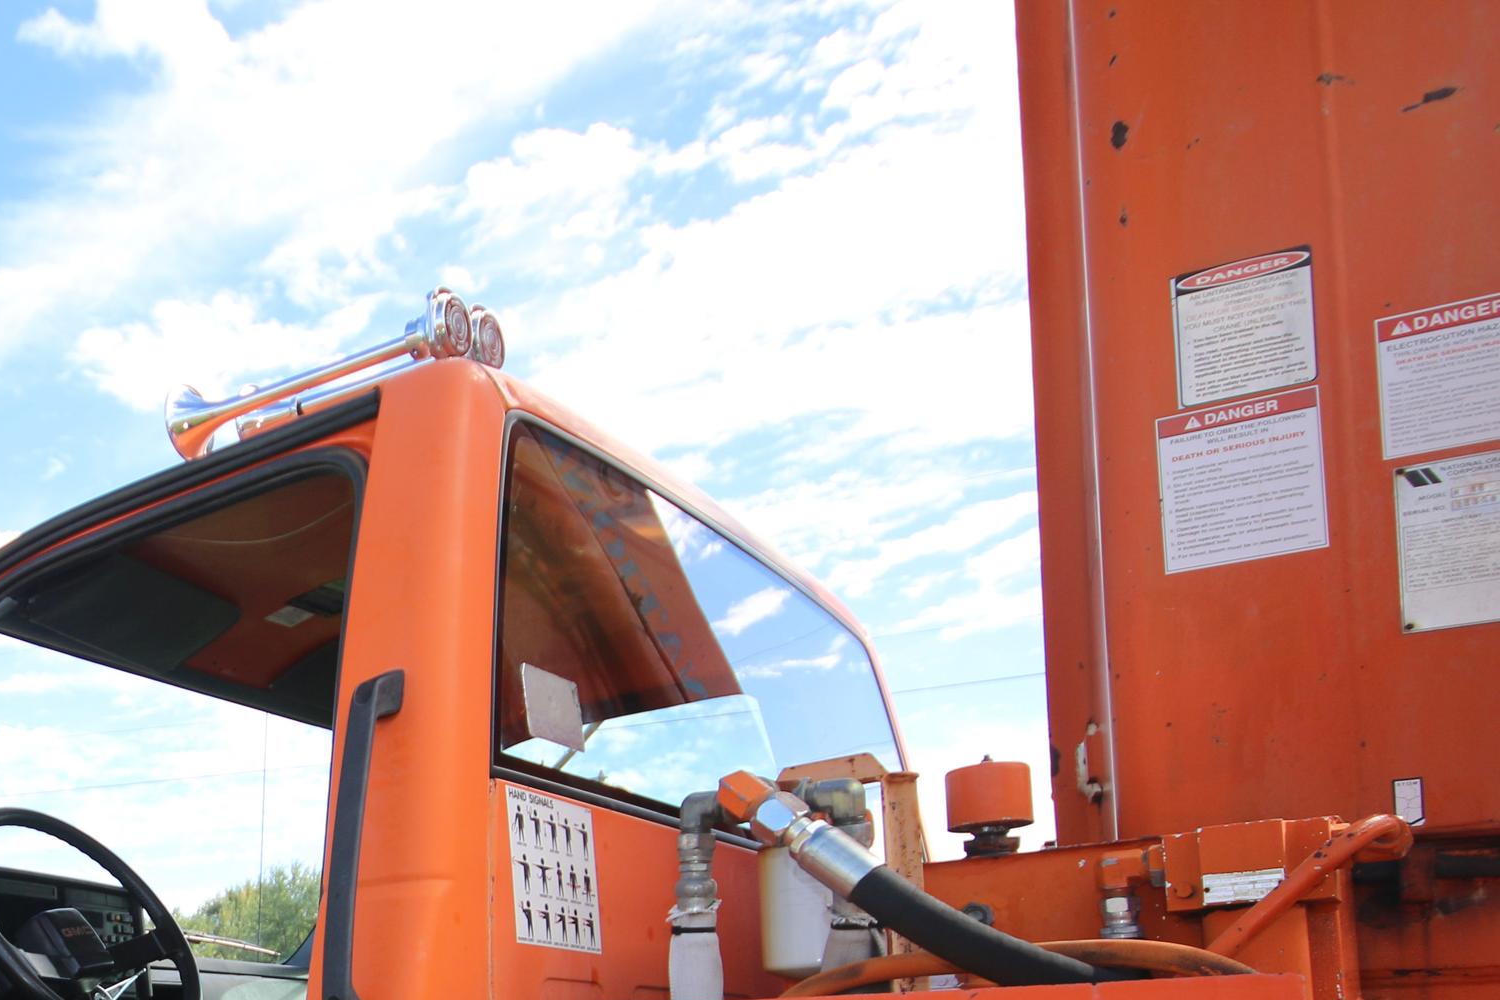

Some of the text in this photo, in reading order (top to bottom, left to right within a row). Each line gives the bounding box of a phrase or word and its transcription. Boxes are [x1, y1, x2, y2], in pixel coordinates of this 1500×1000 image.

[1196, 257, 1290, 285] DANGER
[1387, 325, 1475, 352] ELECTROCUTION
[1204, 400, 1278, 425] DANGER
[1170, 434, 1202, 444] FAILURE
[1217, 427, 1238, 436] OBEY
[1241, 423, 1255, 432] THE
[1257, 413, 1306, 429] FOLLOWING
[1207, 436, 1226, 444] WILL
[1228, 430, 1258, 440] RESULT
[1172, 431, 1305, 463] DEATH OR SERIOUS INJURY
[1440, 460, 1483, 471] NATIONAL
[508, 788, 553, 809] HAND SIGNALS
